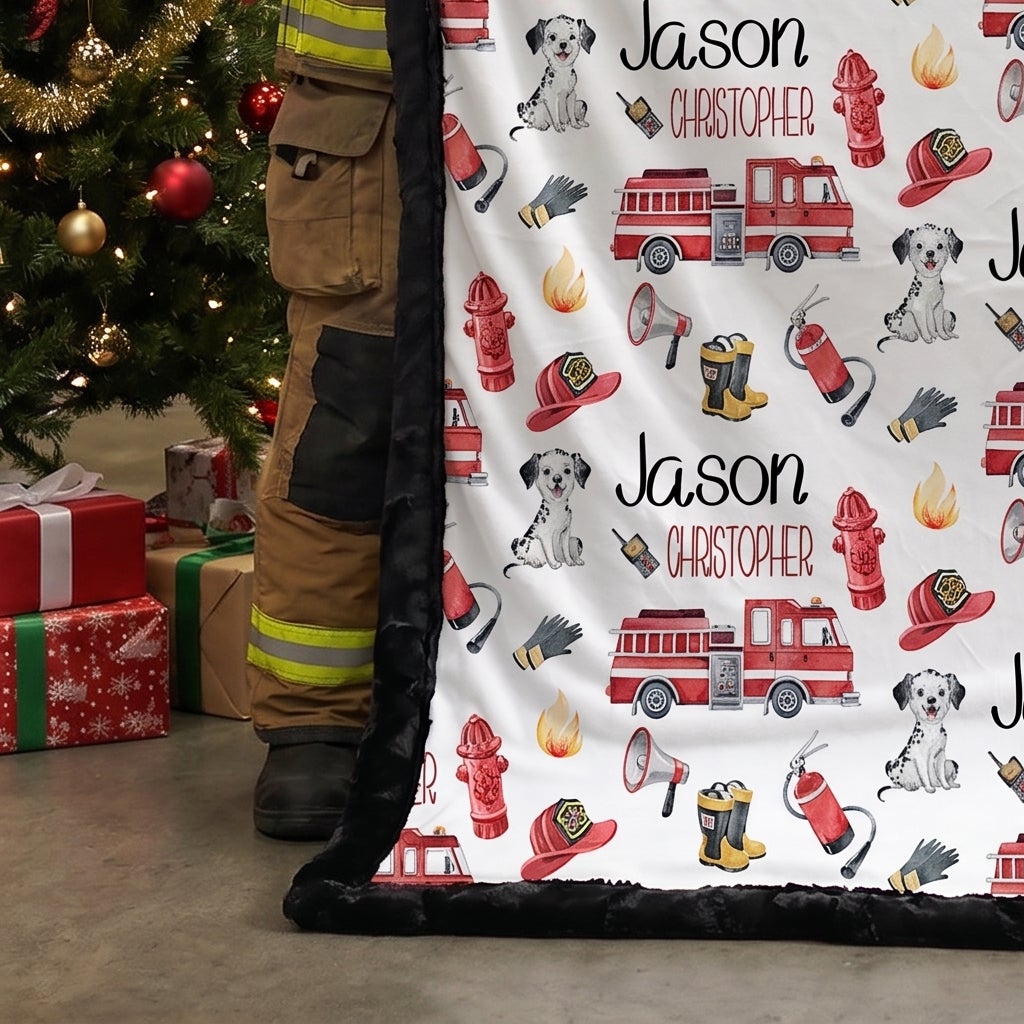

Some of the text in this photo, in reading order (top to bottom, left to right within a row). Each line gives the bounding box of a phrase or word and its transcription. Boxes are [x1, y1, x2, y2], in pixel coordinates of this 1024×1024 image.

[620, 0, 808, 71] Jason
[671, 87, 814, 138] CHRISTOPHER
[616, 432, 808, 507] Jason
[668, 525, 812, 578] CHRISTOPHER
